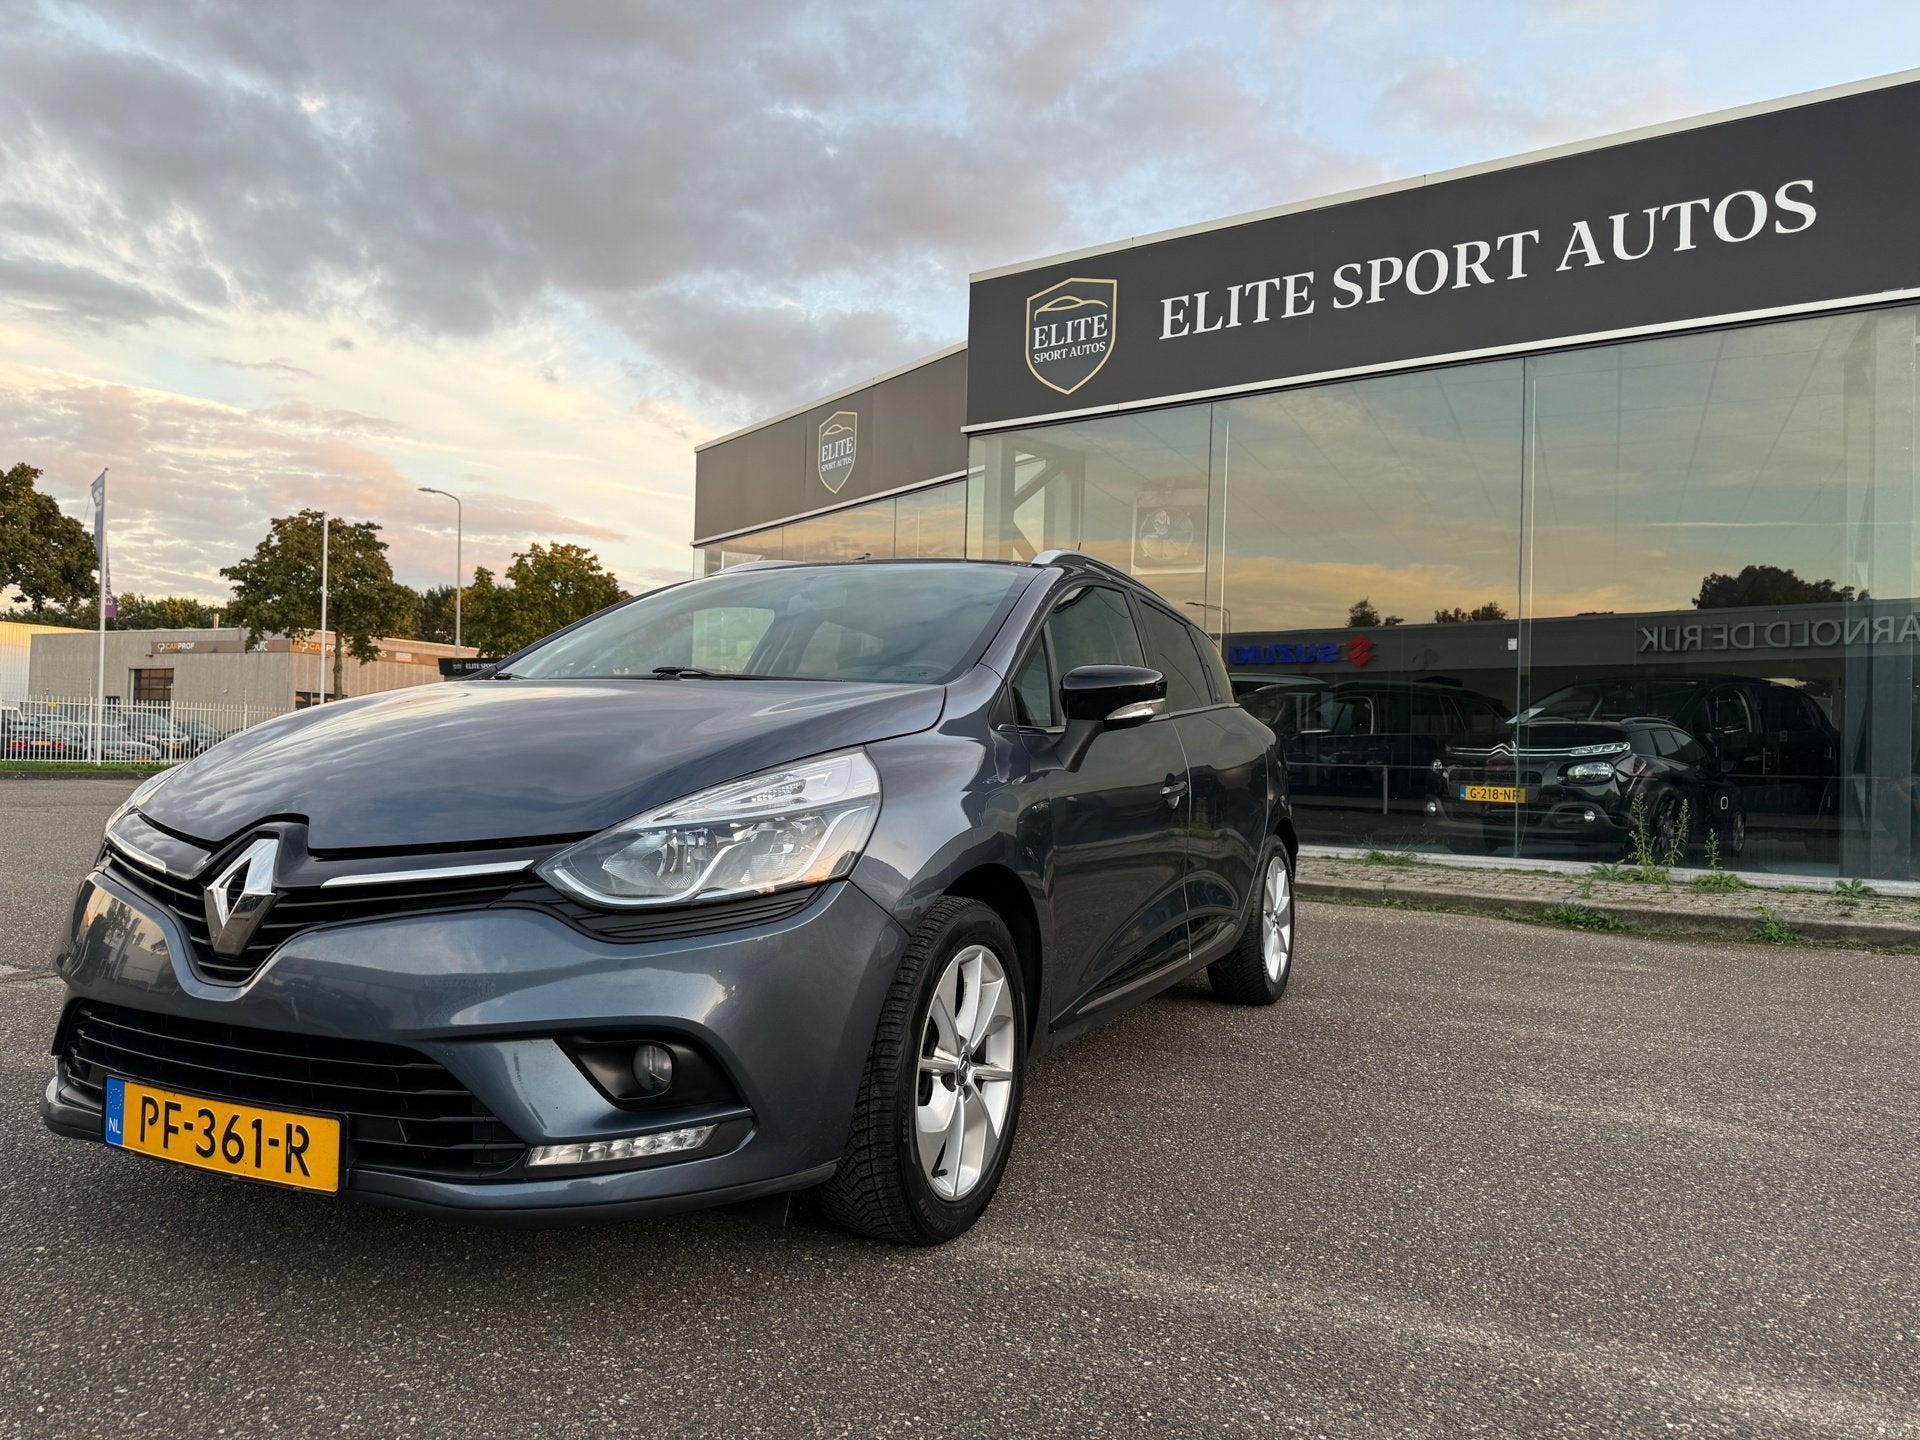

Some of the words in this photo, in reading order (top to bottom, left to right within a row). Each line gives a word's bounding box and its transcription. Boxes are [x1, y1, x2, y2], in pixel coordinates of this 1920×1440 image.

[1159, 271, 1314, 340] ELITE
[1332, 229, 1539, 310] SPORT
[1555, 179, 1818, 272] AUTOS
[1033, 314, 1108, 350] ELITE
[1034, 347, 1068, 364] SPORT
[1069, 341, 1106, 358] AUTOS
[821, 436, 854, 462] ELITE
[821, 460, 837, 473] SPORT
[836, 455, 853, 468] AUTOS
[165, 641, 195, 651] CARPROF
[108, 1116, 121, 1135] NL
[139, 1094, 311, 1178] PF-361-R
